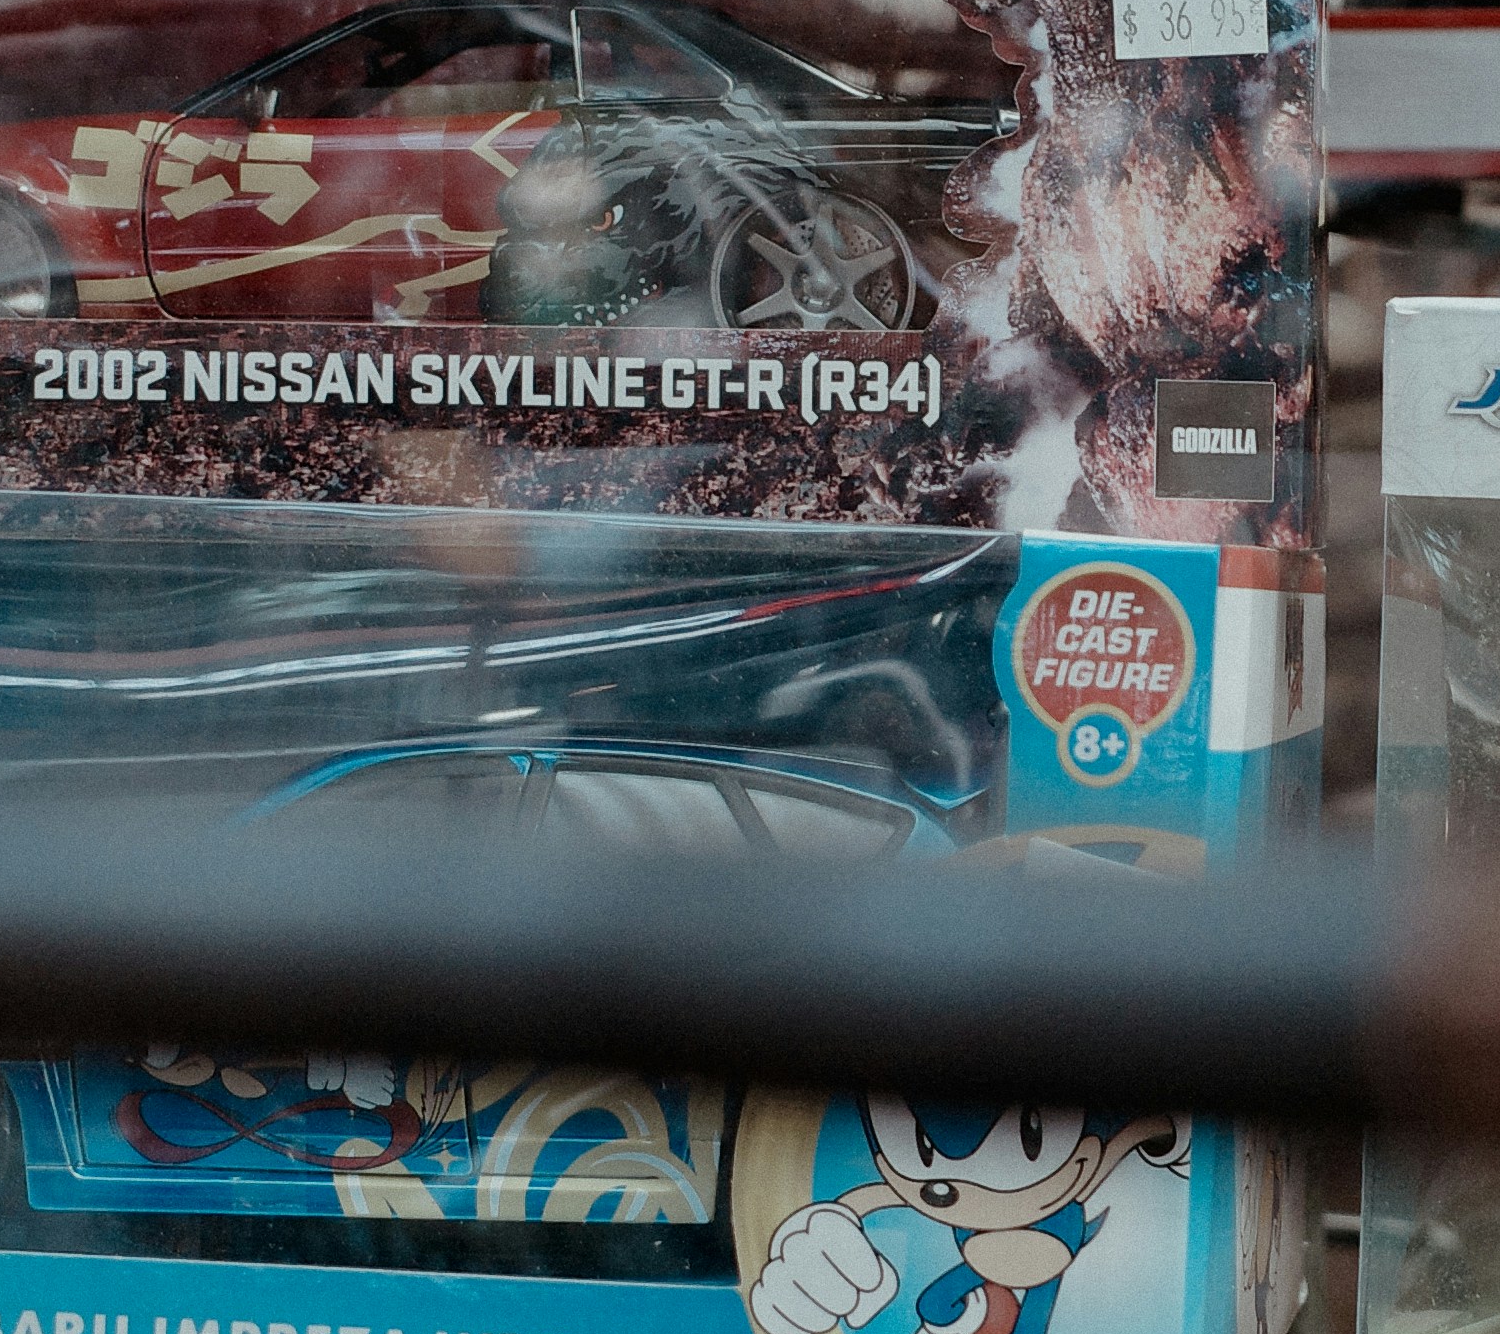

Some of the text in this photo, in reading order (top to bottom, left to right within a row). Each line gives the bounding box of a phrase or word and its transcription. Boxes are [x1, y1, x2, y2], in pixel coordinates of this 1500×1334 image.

[1159, 0, 1192, 42] 36
[33, 348, 942, 427] 2002 NISSAN SKYLINE GT-R (R34)
[1172, 426, 1257, 455] GODZILLA
[1068, 590, 1144, 620] DIE-
[1056, 623, 1158, 656] CAST
[1033, 659, 1174, 693] FIGURE
[1071, 724, 1125, 762] 8+
